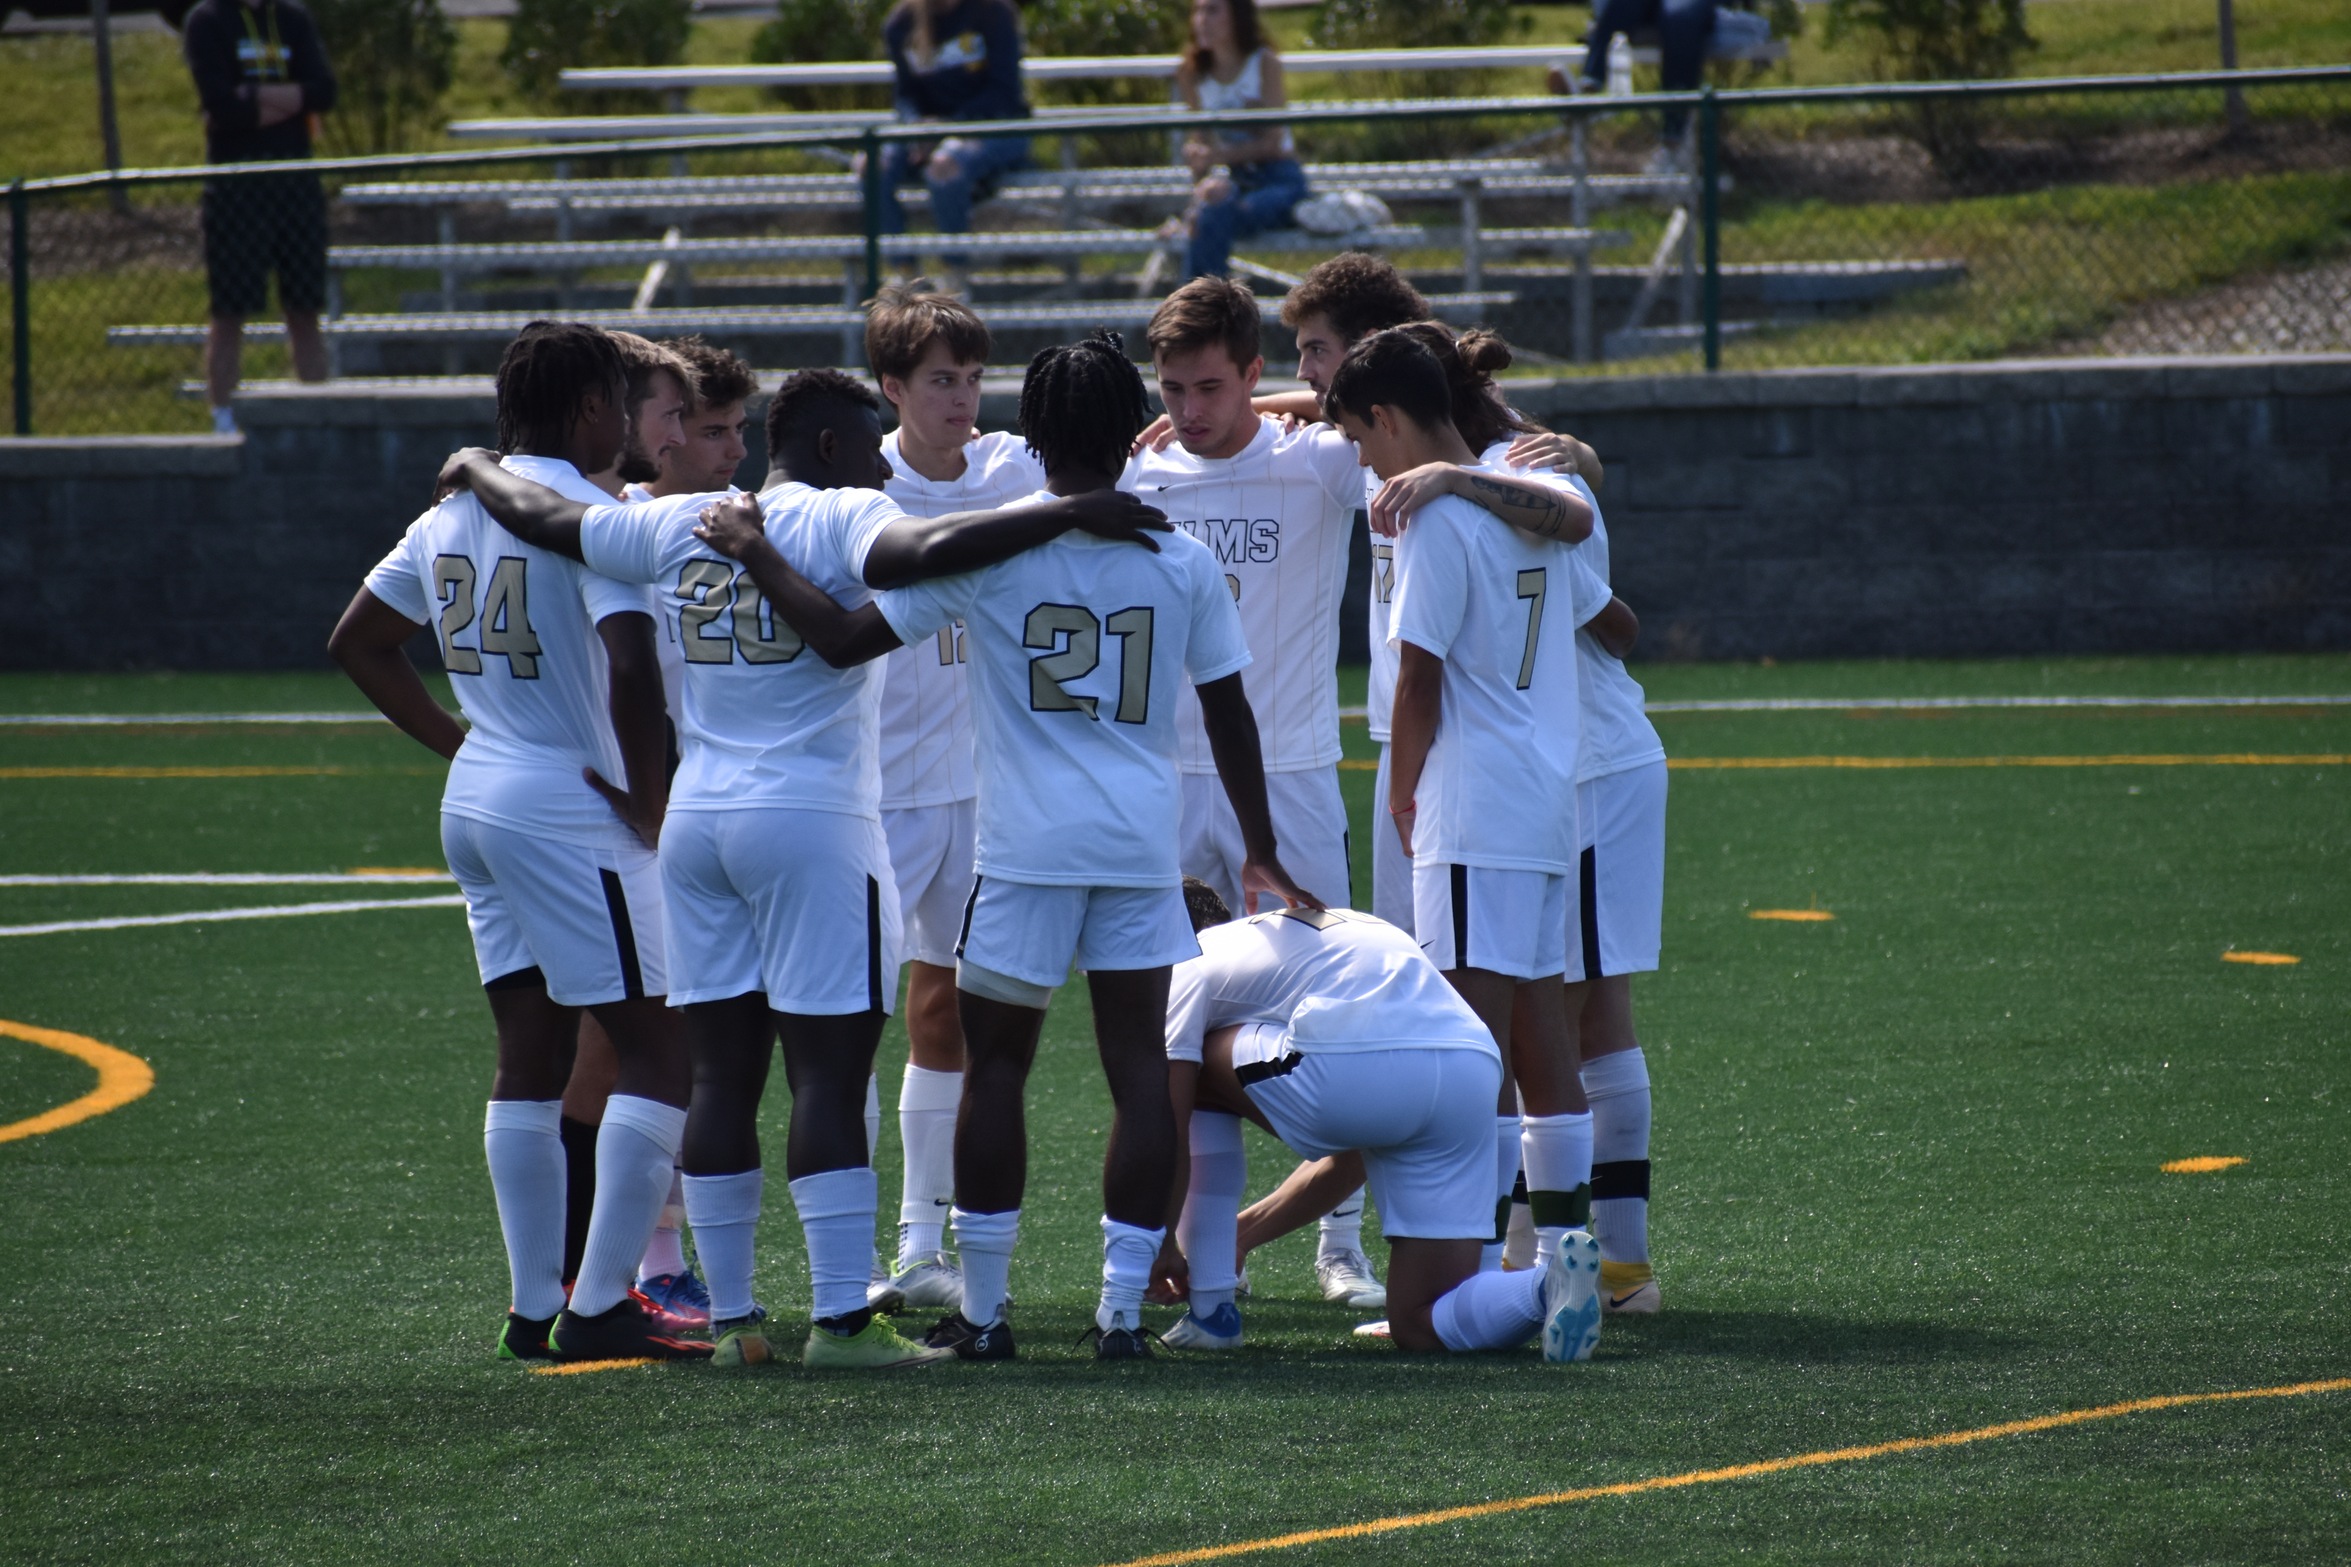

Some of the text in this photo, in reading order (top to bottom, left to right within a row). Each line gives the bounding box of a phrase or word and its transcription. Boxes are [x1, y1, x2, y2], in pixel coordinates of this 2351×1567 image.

[1170, 518, 1279, 565] MS
[433, 553, 543, 680] 24
[674, 558, 805, 665] 20
[1022, 602, 1154, 725] 21
[1517, 567, 1547, 691] 7
